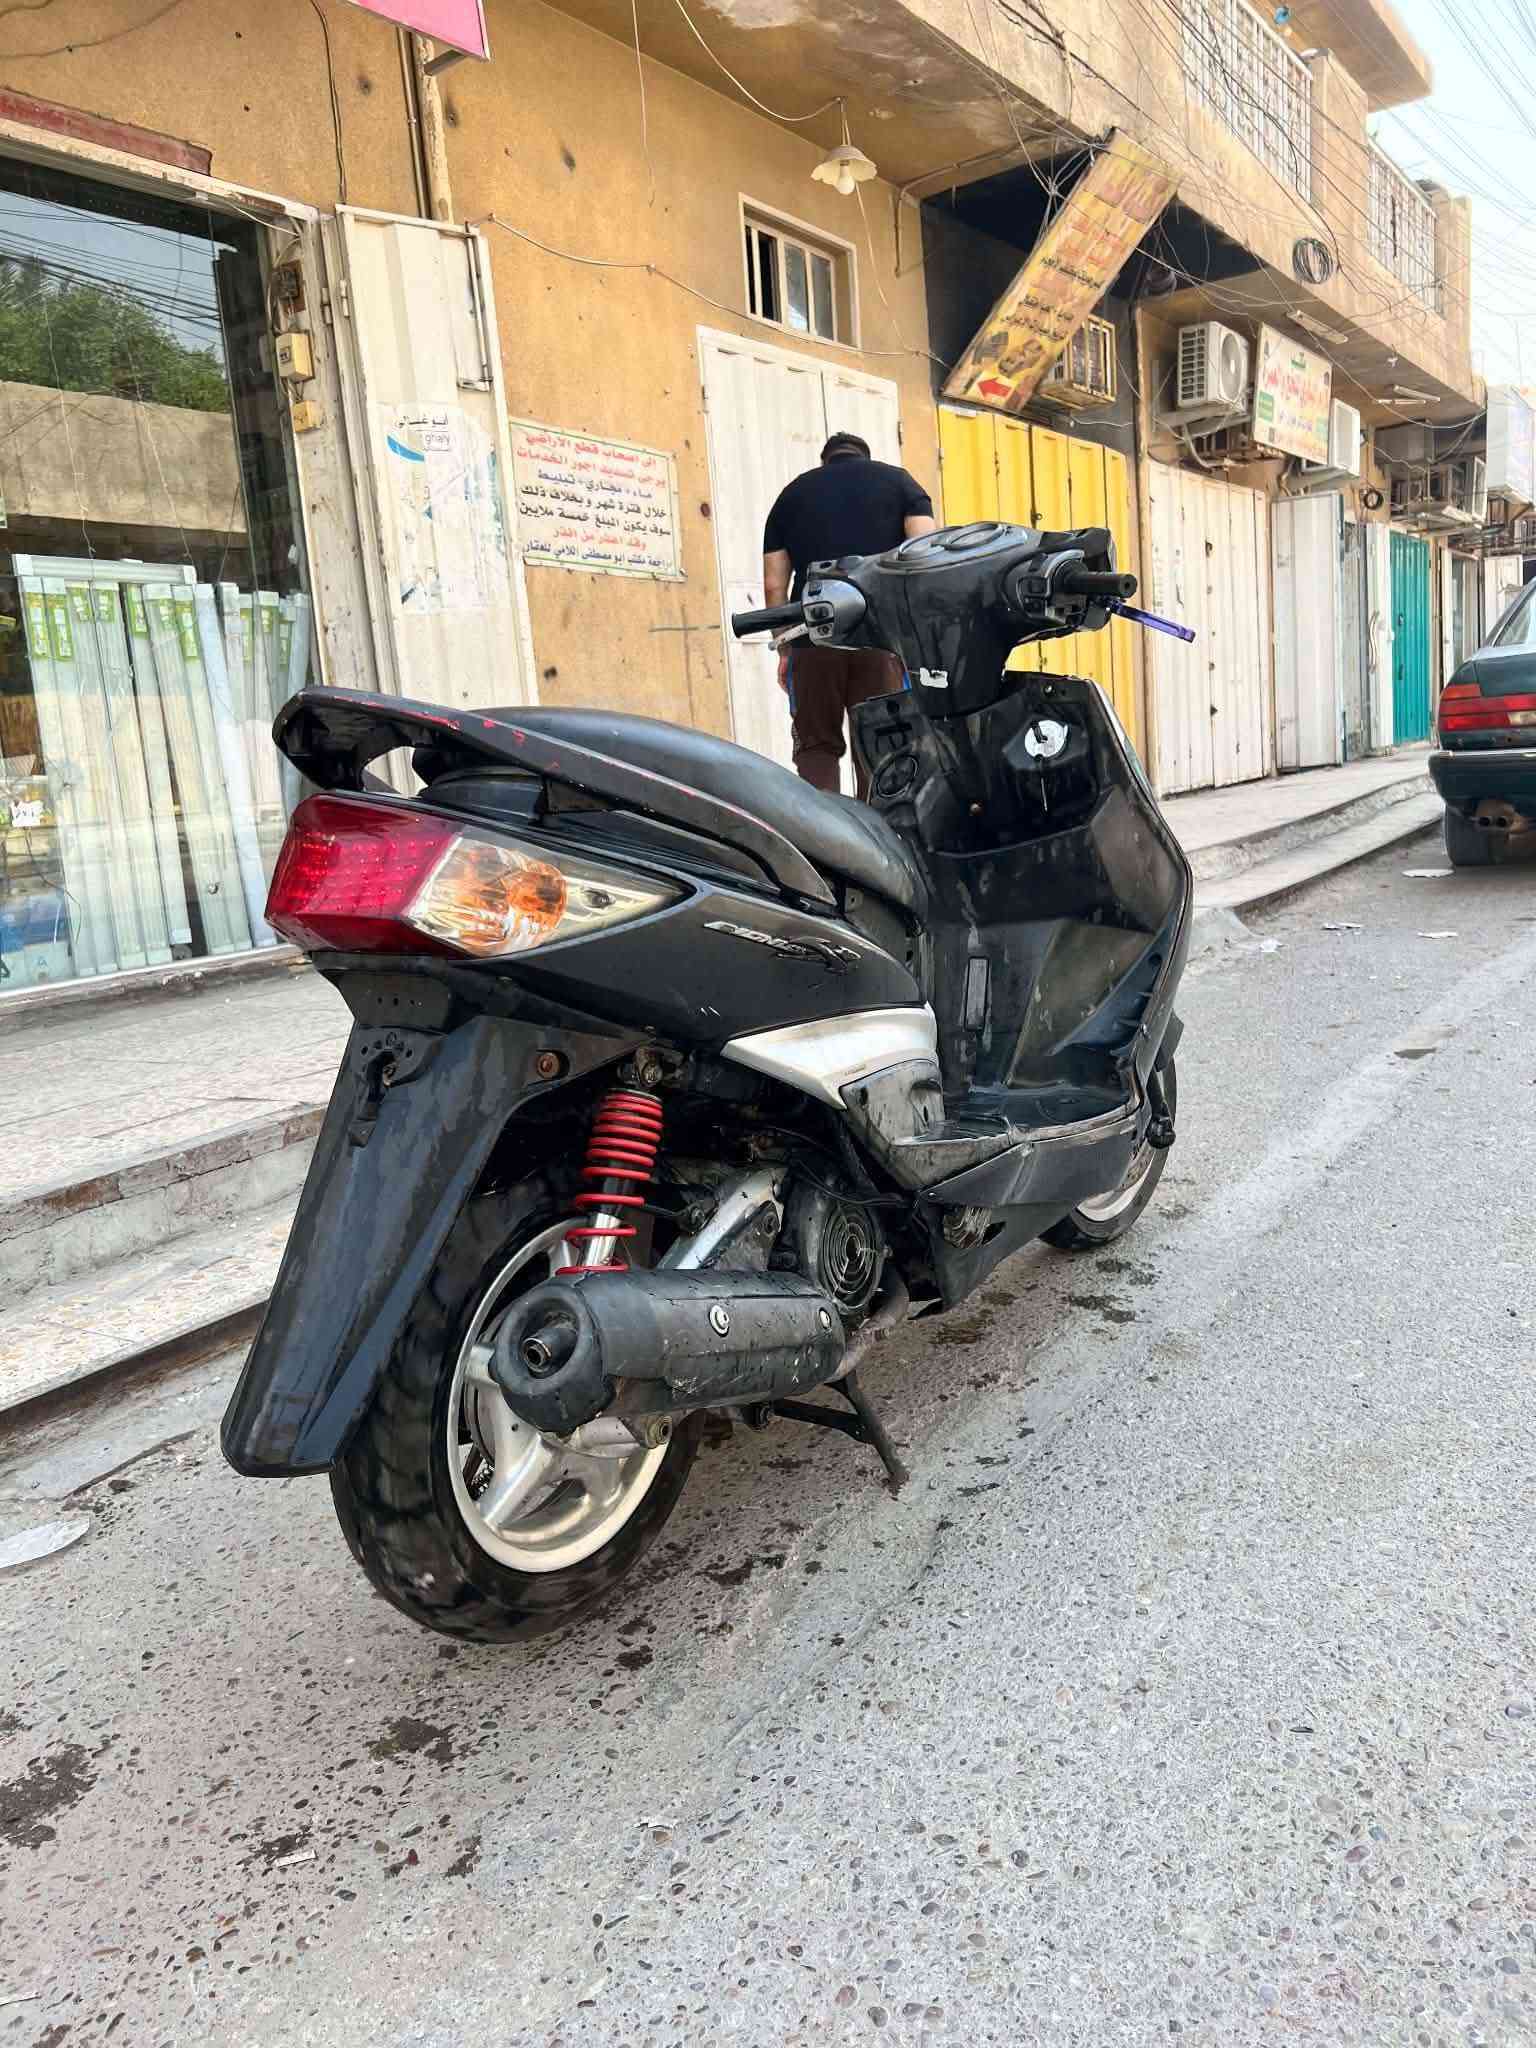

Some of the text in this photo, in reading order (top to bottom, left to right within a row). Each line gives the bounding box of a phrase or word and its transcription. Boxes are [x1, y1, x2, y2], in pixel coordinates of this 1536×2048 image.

[526, 432, 571, 448] الاراضي
[575, 442, 599, 454] قطع
[516, 448, 567, 465] الخدمات
[520, 485, 546, 499] ذلك
[596, 497, 615, 510] شهر
[619, 501, 641, 515] فترة
[644, 505, 666, 519] خلال
[519, 502, 671, 537] سوف يكون المبلغ خمسة ملايين
[581, 547, 611, 561] مصطفى
